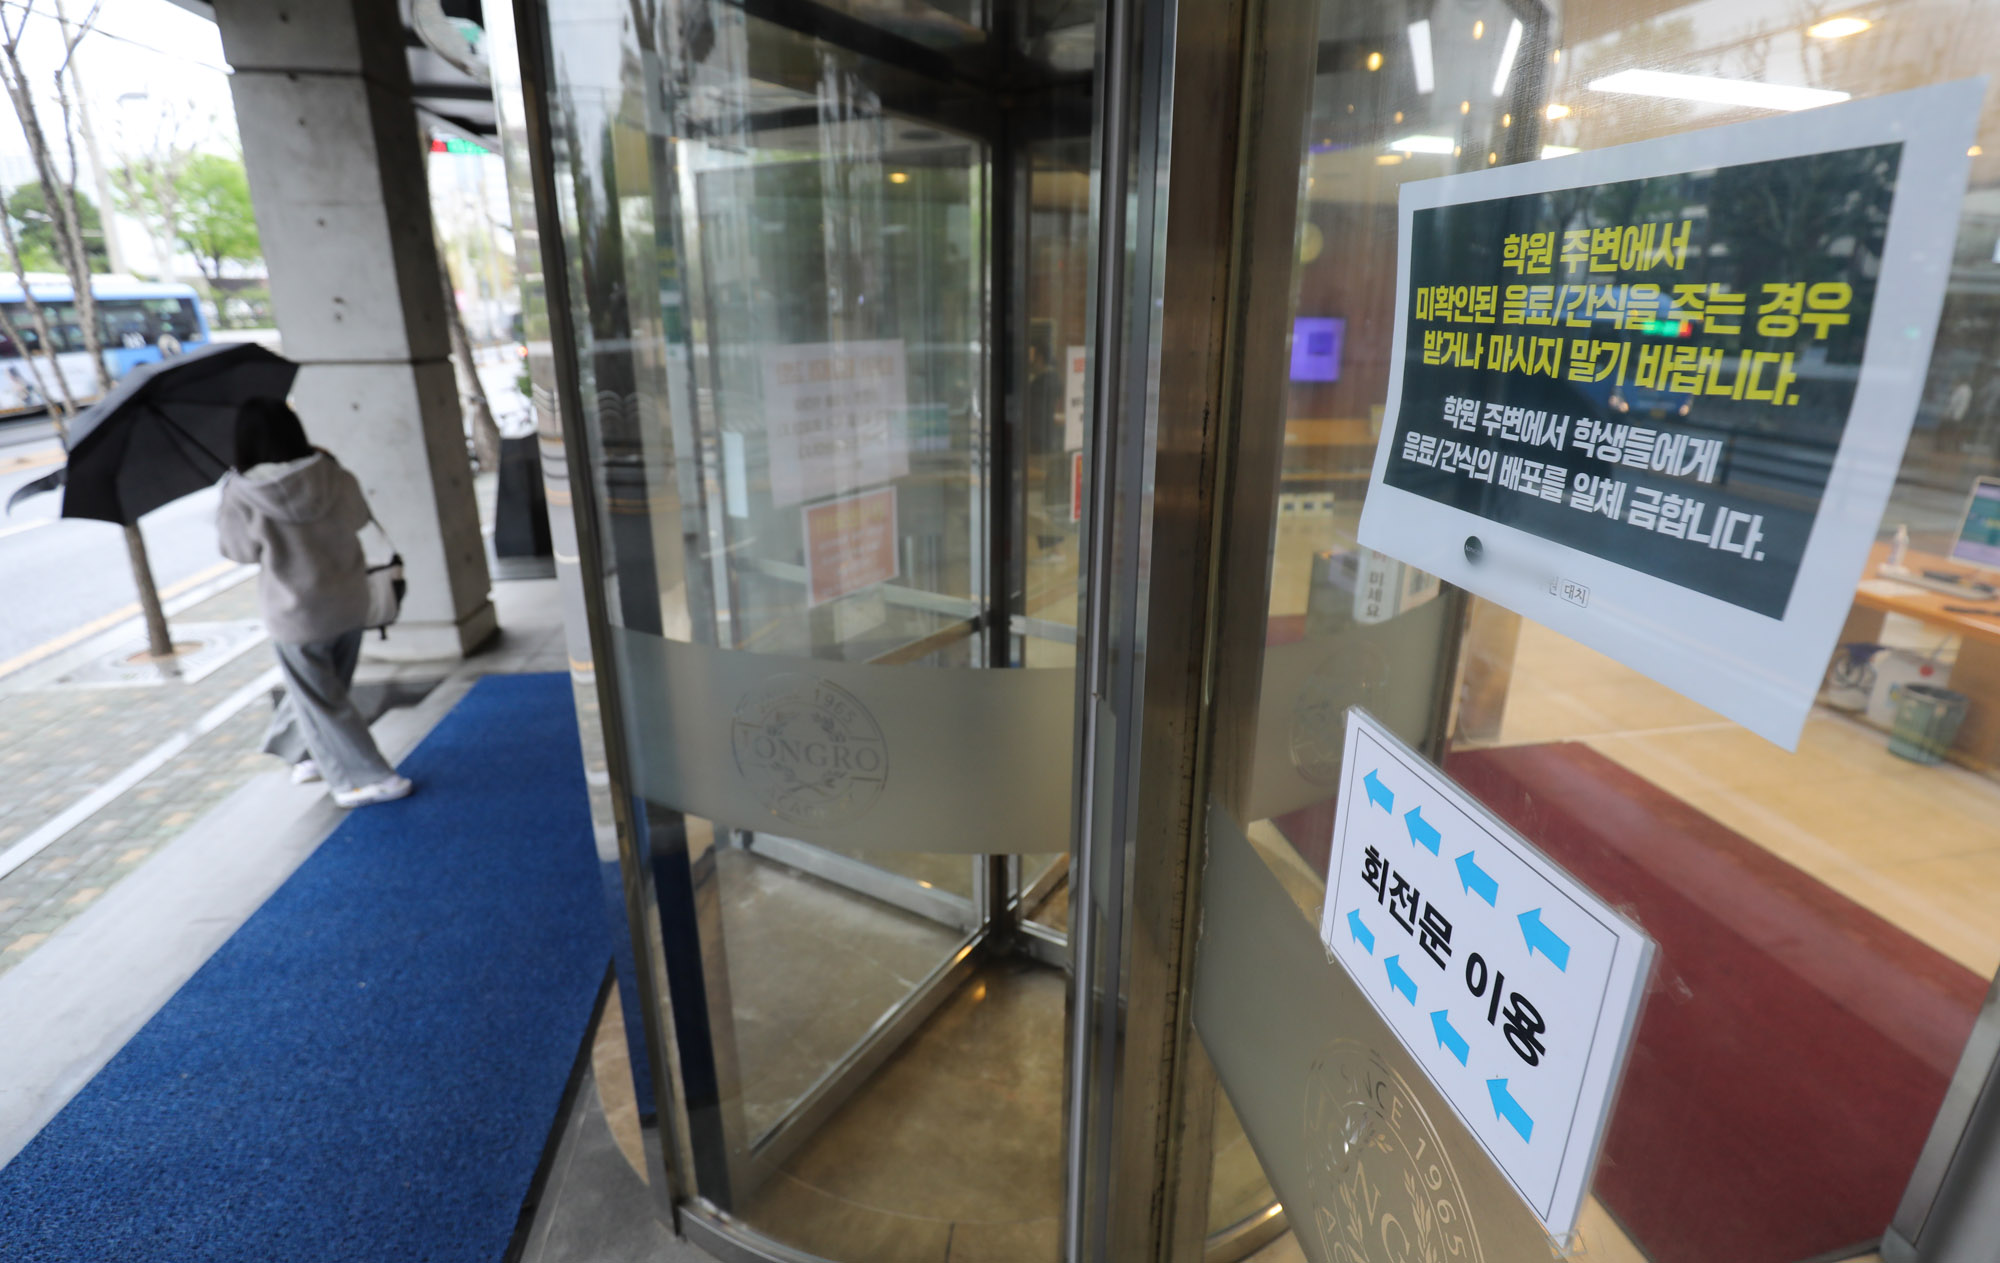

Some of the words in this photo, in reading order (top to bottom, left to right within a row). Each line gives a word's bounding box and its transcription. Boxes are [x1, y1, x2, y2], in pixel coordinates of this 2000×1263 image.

[1503, 232, 1555, 275] 학원
[1560, 220, 1692, 274] 주변에서
[1416, 285, 1498, 324] 미확인된
[1502, 283, 1661, 331] 음료/간식을
[1667, 282, 1747, 335] 주는
[1756, 281, 1853, 340] 경우
[1423, 329, 1484, 370] 받거나
[1487, 334, 1564, 379] 마시지
[1567, 339, 1632, 387] 말기
[1633, 344, 1800, 406] 바랍니다.
[1443, 395, 1481, 433] 학원
[1482, 402, 1570, 451] 주변에서
[1572, 417, 1723, 484] 학생들에게
[1402, 430, 1498, 484] 음료/간식의
[1498, 455, 1568, 504] 배포를
[1569, 472, 1627, 521] 일체
[1627, 486, 1765, 562] 금합니다.
[1564, 584, 1587, 604] 대치
[1361, 844, 1453, 972] 회전문
[1465, 952, 1546, 1068] 이용
[1415, 1137, 1467, 1258] 1965
